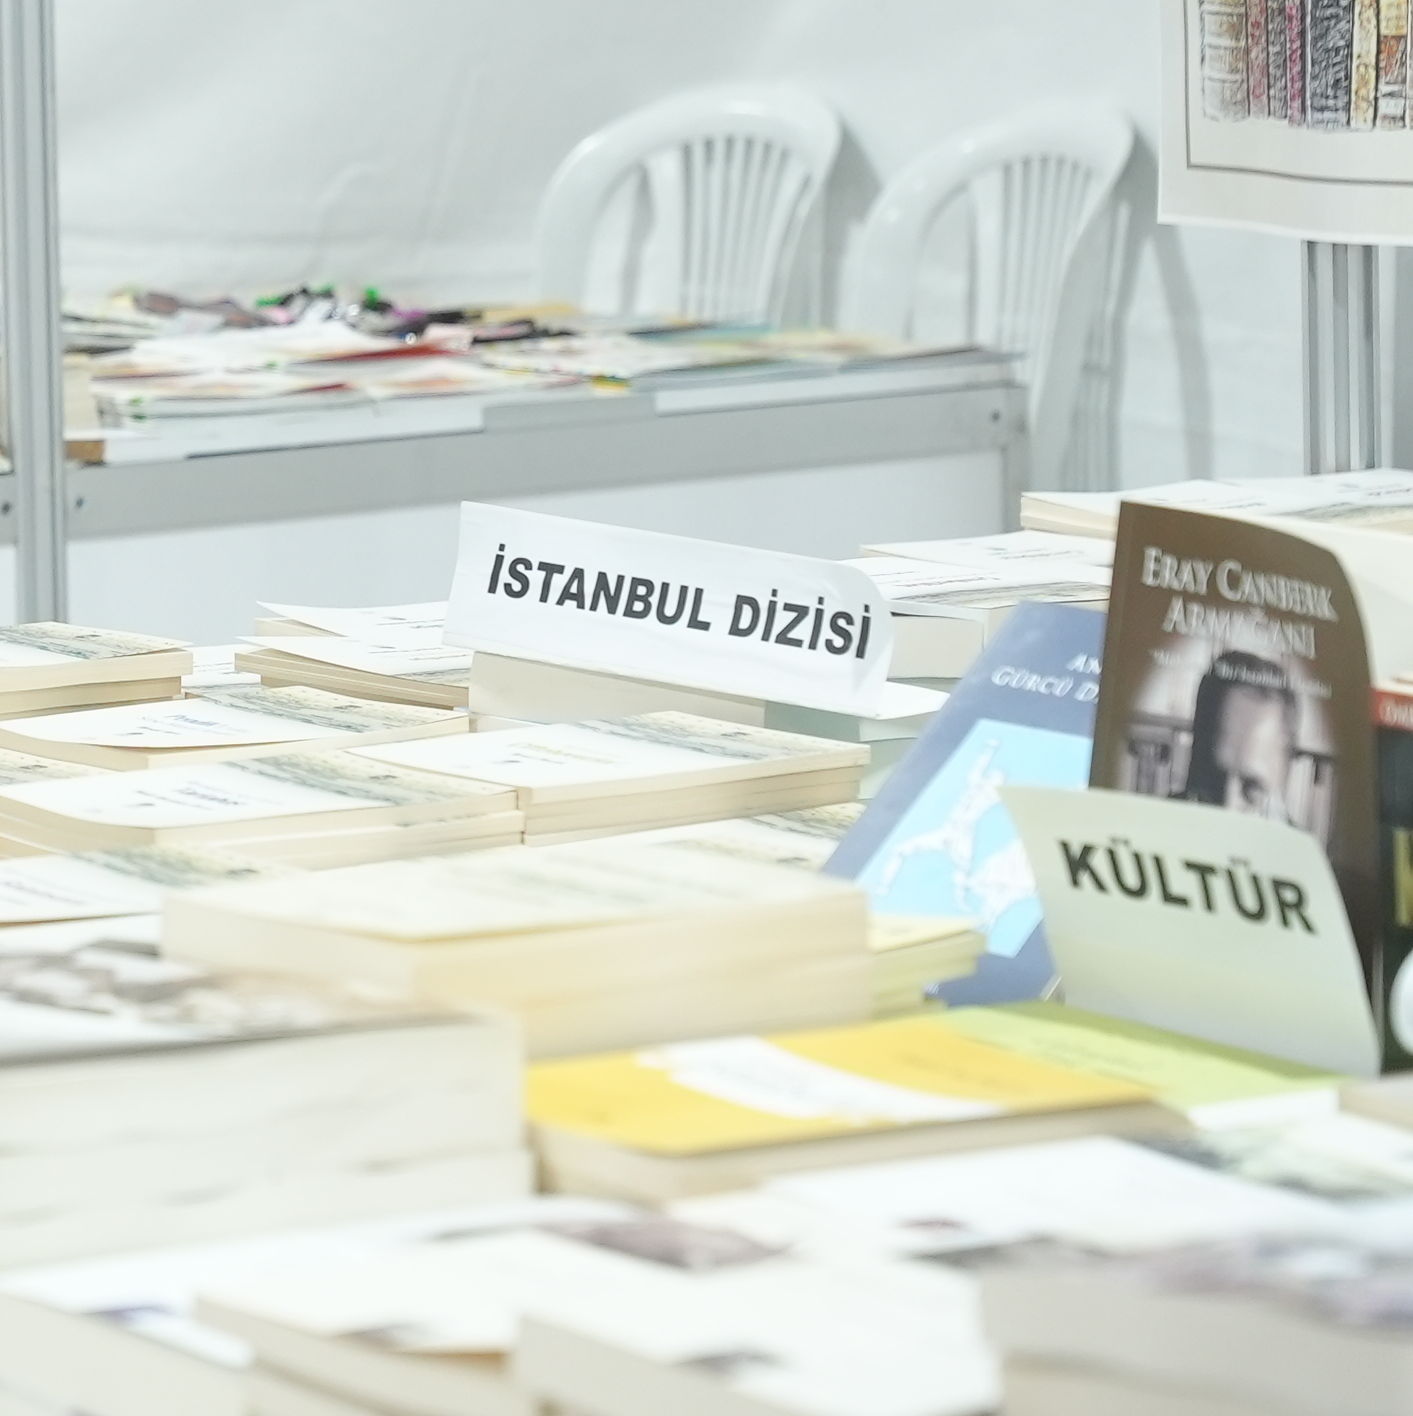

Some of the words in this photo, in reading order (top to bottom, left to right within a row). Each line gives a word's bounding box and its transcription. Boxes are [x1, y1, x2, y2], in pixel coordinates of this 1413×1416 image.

[486, 543, 712, 632] İSTANBUL
[728, 588, 873, 661] DİZİSİ
[1141, 545, 1215, 596] ERAY
[1057, 834, 1319, 937] KÜLTÜR
